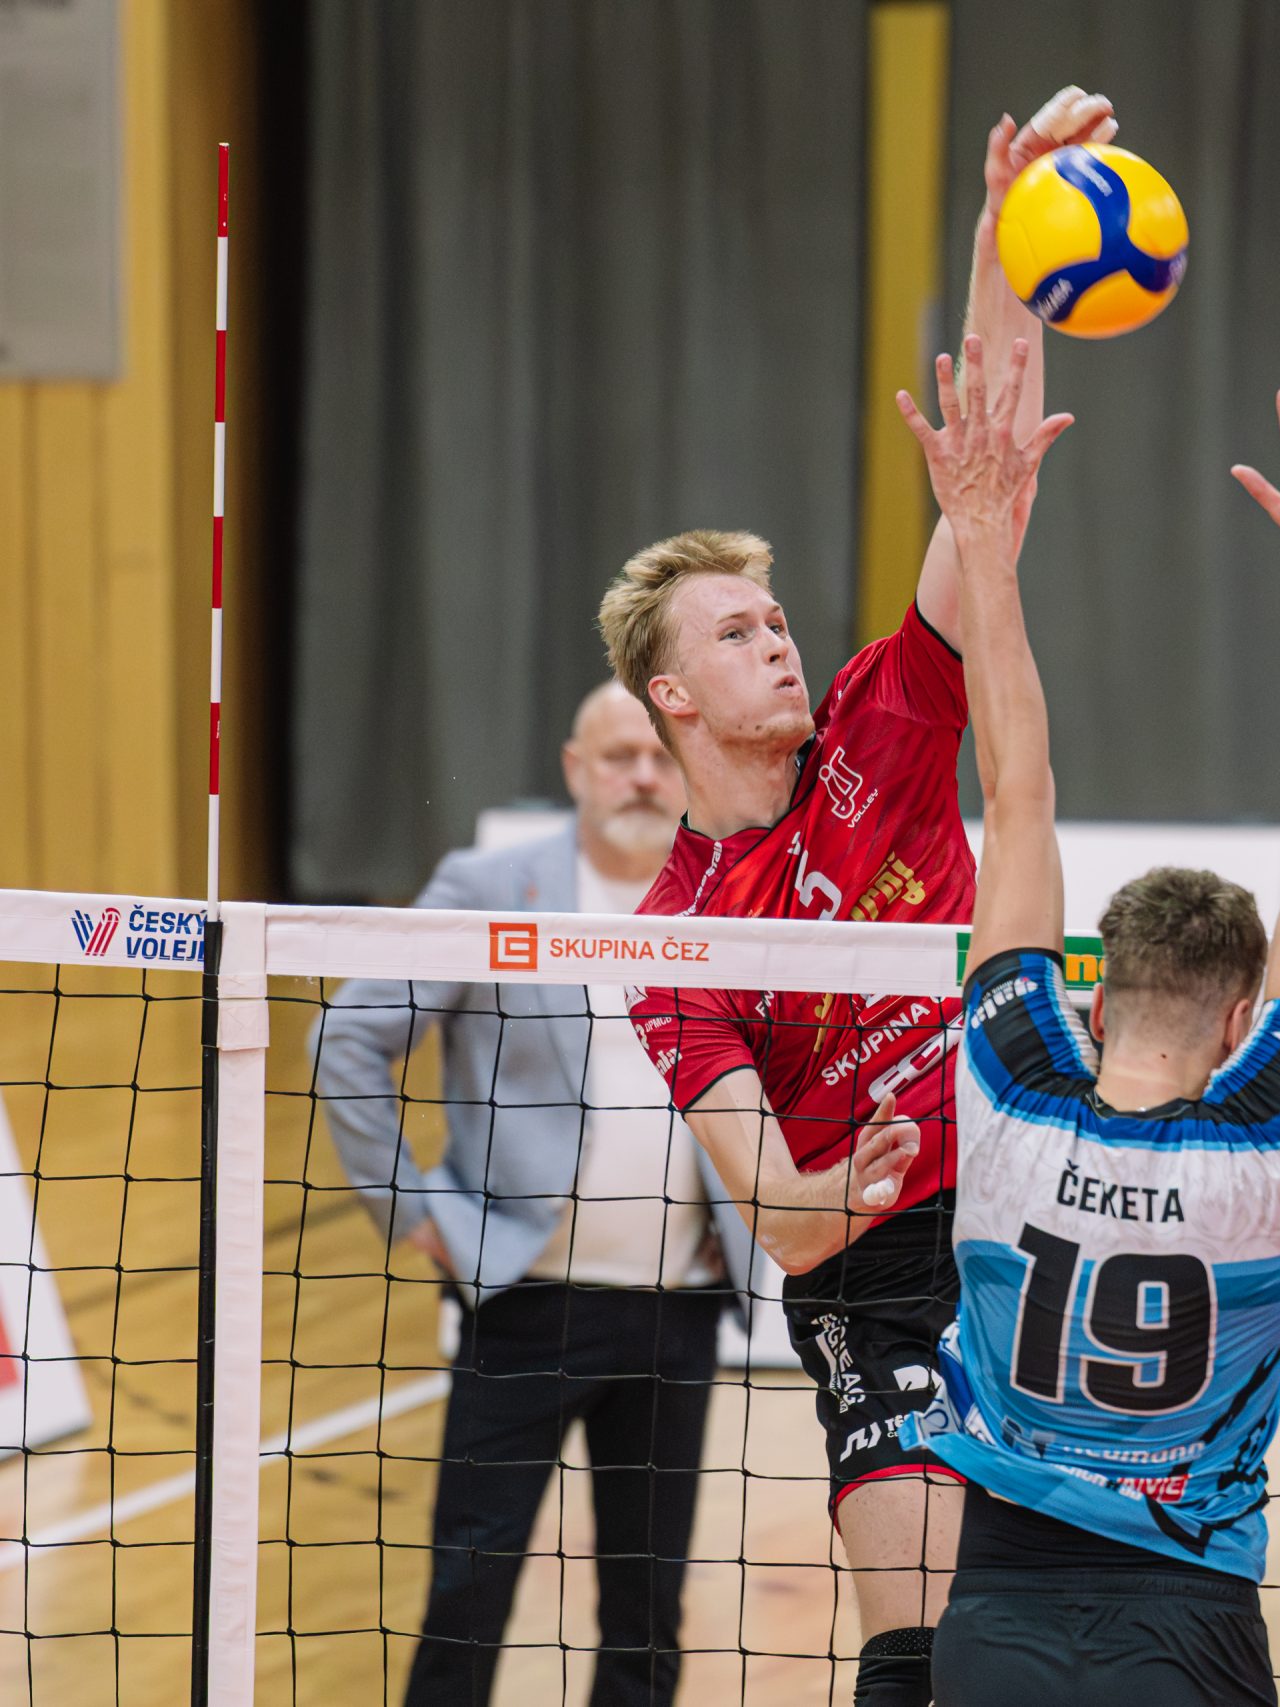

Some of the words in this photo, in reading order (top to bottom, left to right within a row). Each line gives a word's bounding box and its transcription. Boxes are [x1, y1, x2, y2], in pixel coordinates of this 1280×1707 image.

[848, 788, 878, 828] VOLLEY
[126, 937, 204, 962] VOLEJ
[550, 937, 654, 960] SKUPINA
[661, 936, 709, 961] ČEZ
[821, 1002, 930, 1086] SKUPINA
[1056, 1159, 1185, 1222] ČEKETA
[1009, 1222, 1218, 1417] 19
